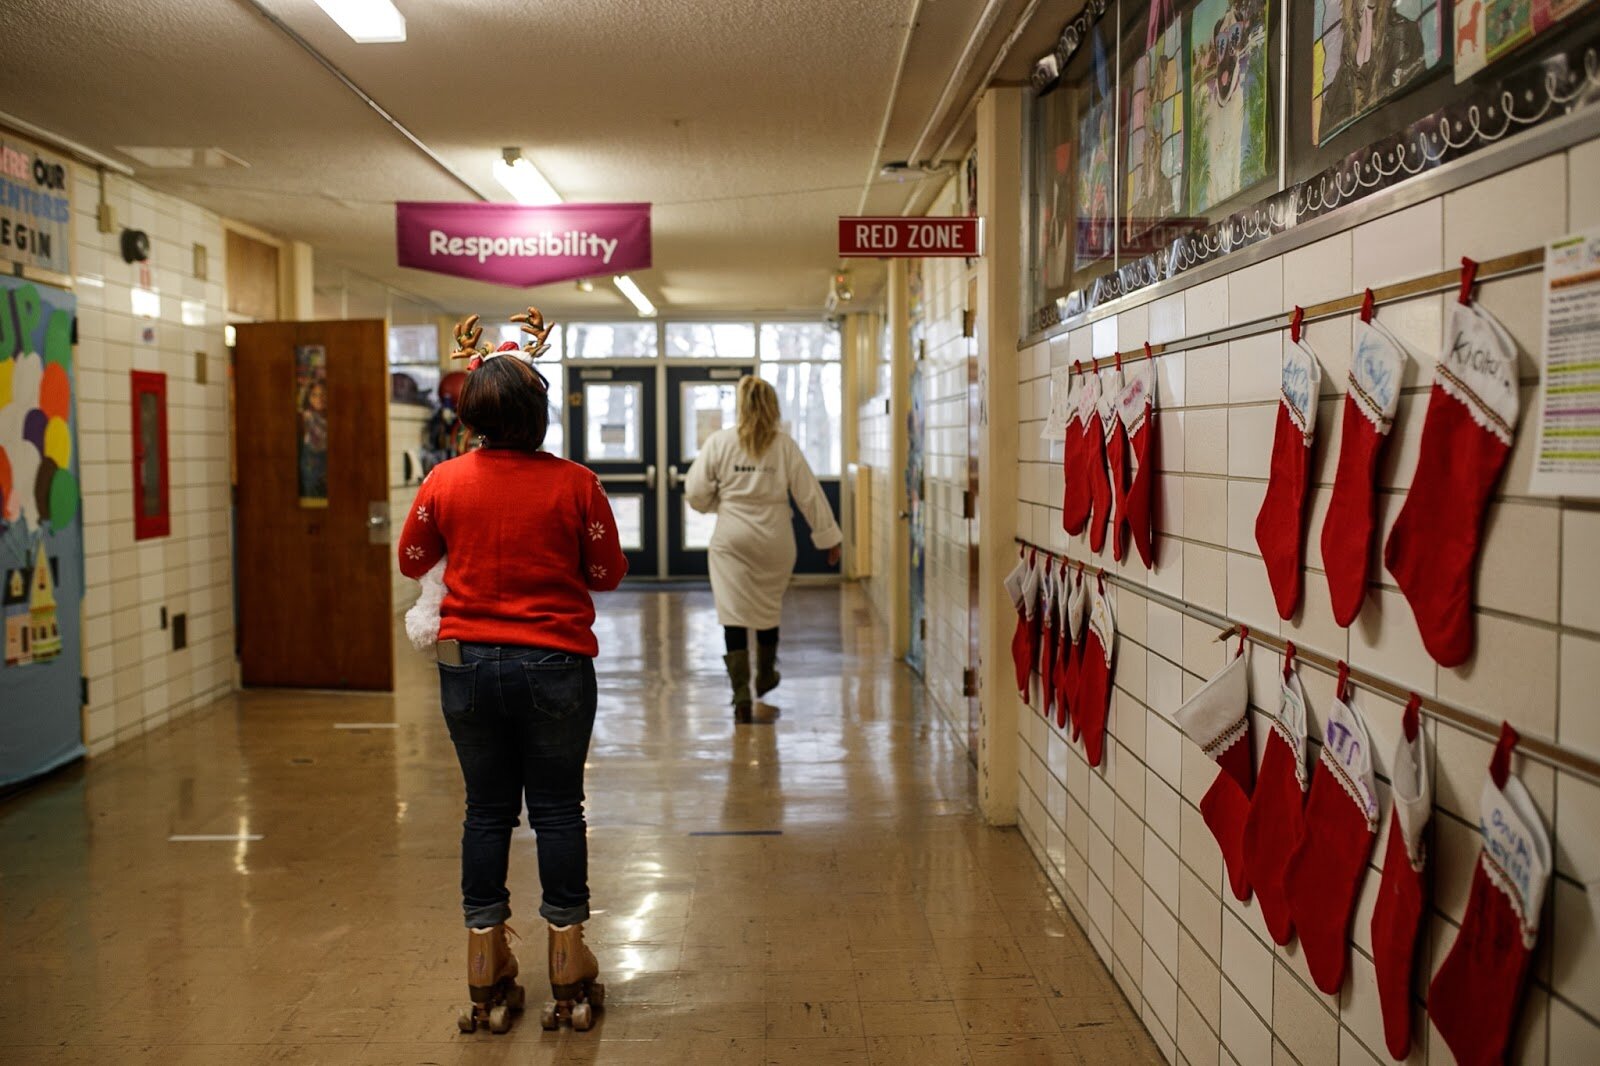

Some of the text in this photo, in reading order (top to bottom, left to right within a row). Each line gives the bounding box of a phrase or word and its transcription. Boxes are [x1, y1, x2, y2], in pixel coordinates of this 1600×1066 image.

[33, 157, 65, 190] OUR
[429, 230, 618, 264] Responsibility
[856, 225, 964, 248] RED ZONE
